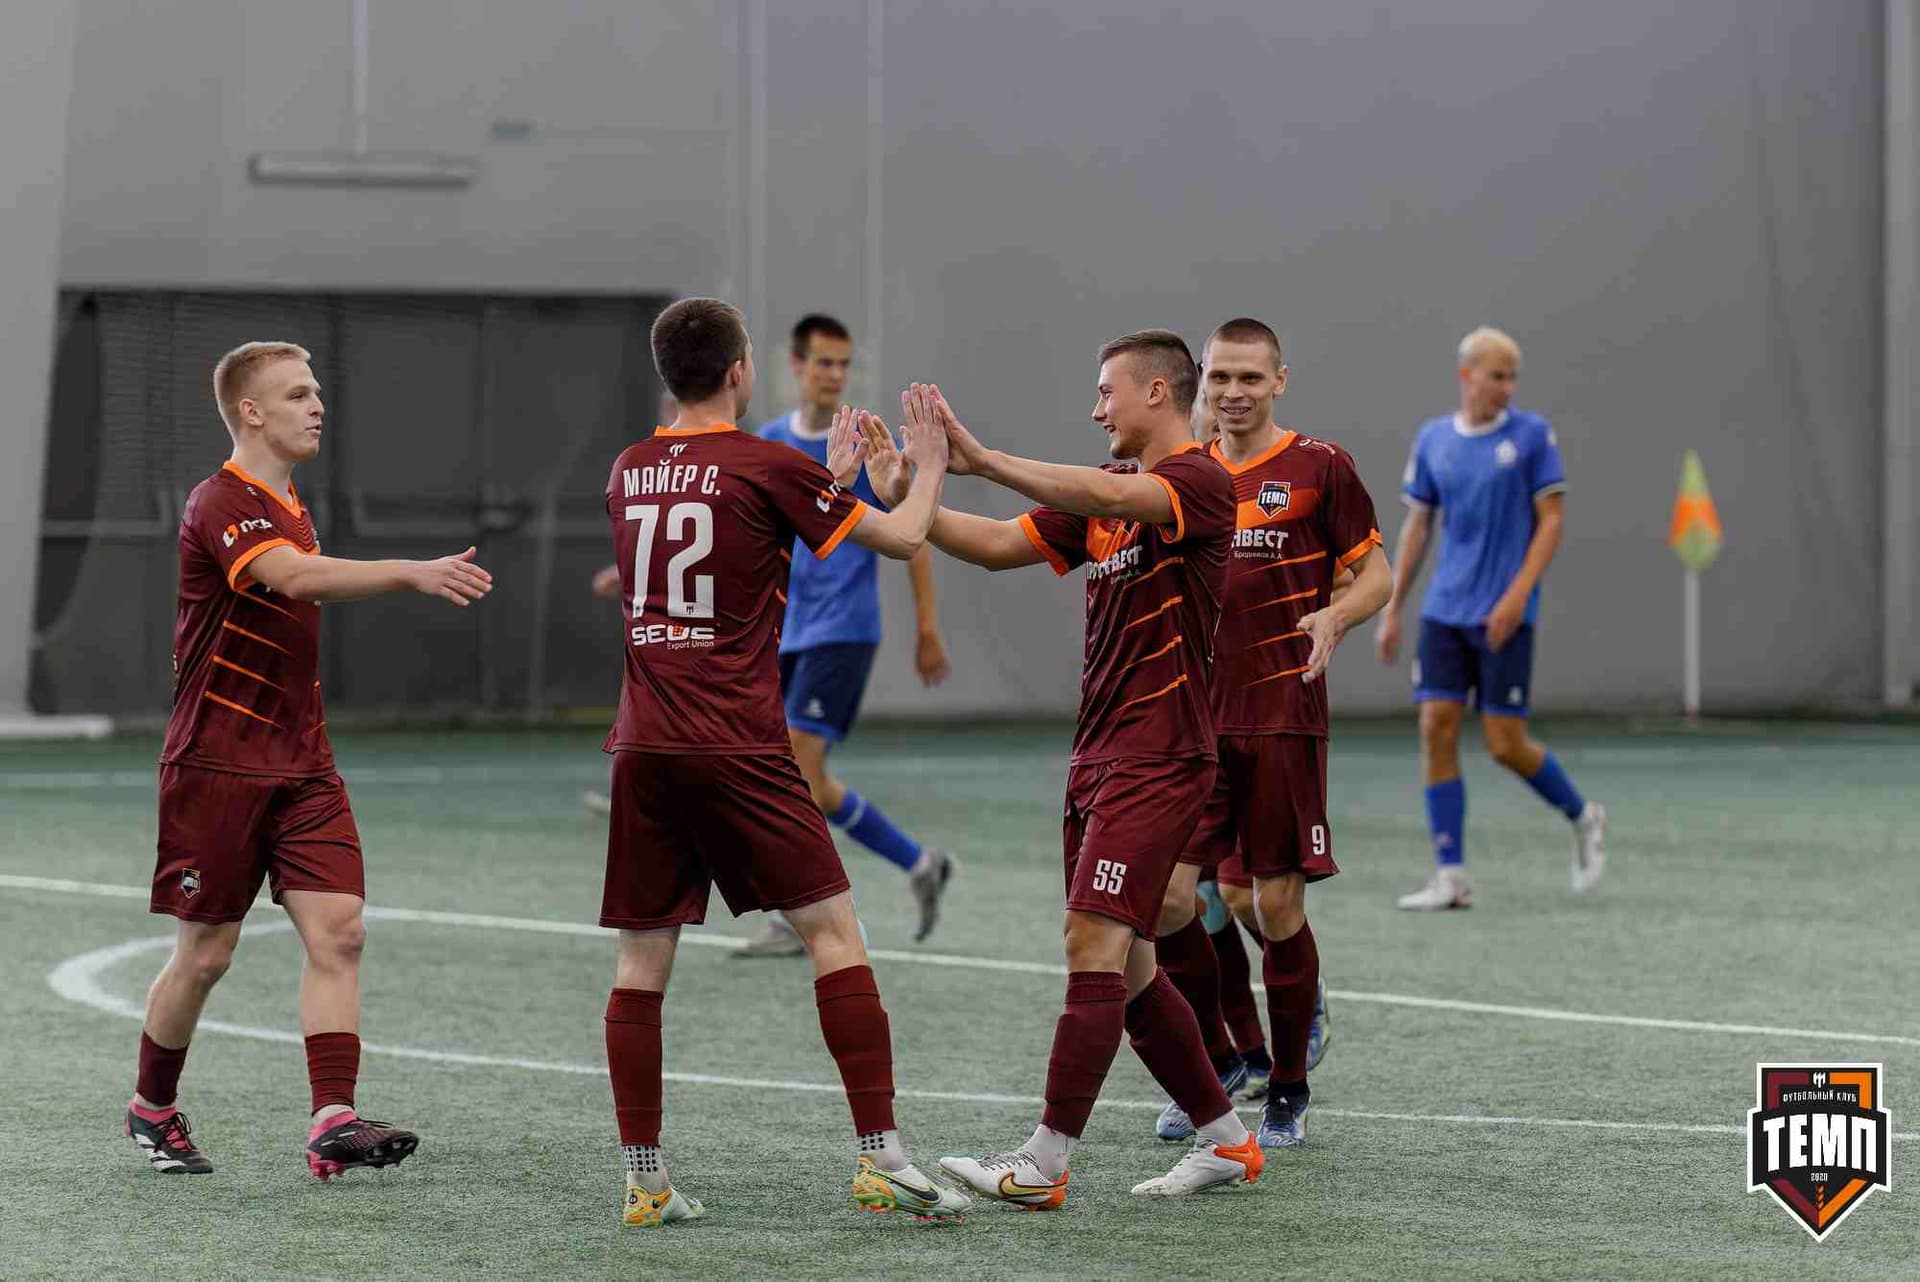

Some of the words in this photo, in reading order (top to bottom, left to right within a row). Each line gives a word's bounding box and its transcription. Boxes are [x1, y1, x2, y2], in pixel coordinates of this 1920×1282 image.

[623, 459, 698, 498] МАЙЕР
[701, 465, 722, 496] С.
[1260, 490, 1288, 506] ТЕМП
[625, 502, 715, 619] 72
[666, 642, 690, 650] Export
[691, 640, 714, 648] Union
[1311, 824, 1326, 856] 9
[1092, 859, 1128, 895] 55
